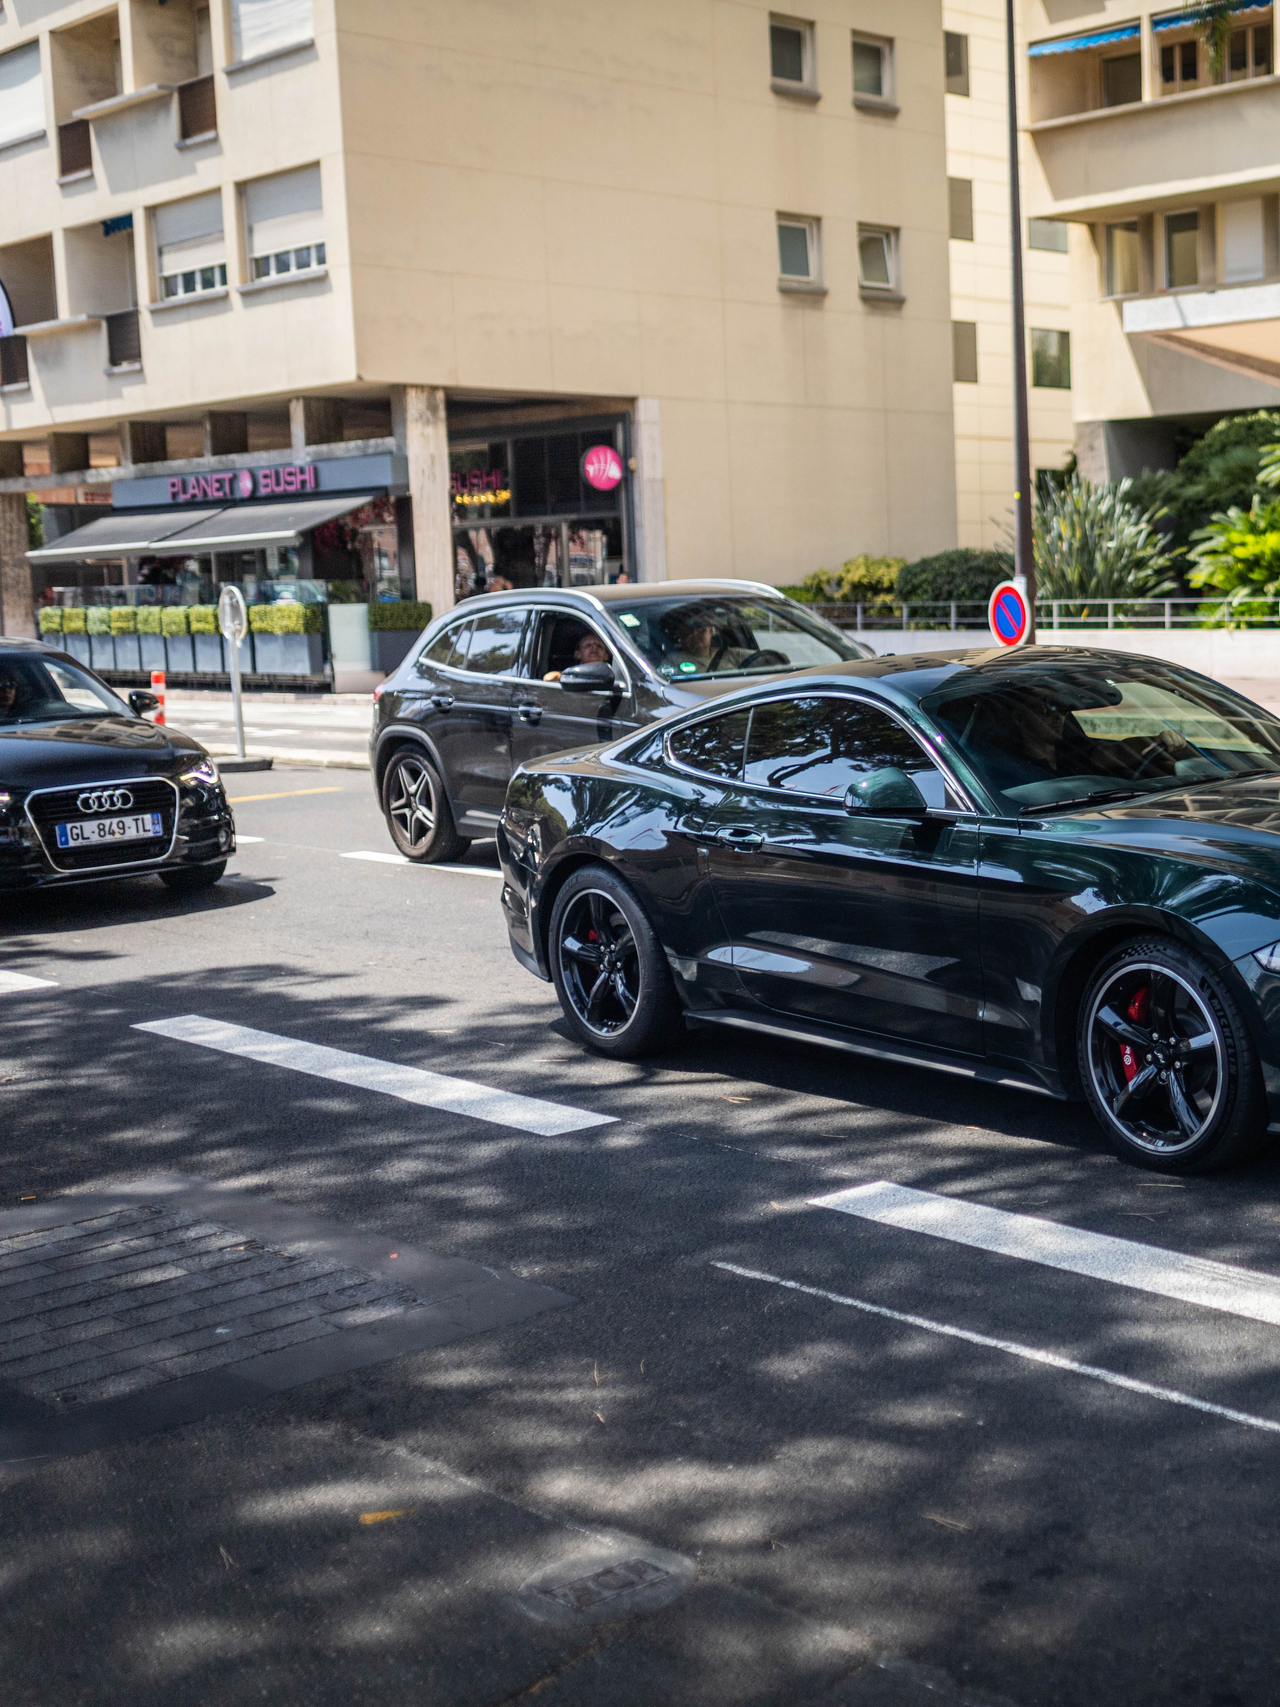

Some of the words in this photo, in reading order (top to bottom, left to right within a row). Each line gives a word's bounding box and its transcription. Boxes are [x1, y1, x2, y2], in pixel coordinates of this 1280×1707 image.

[168, 472, 235, 500] PLANET
[259, 464, 316, 494] SUSHI
[1210, 998, 1238, 1075] MICHELIN
